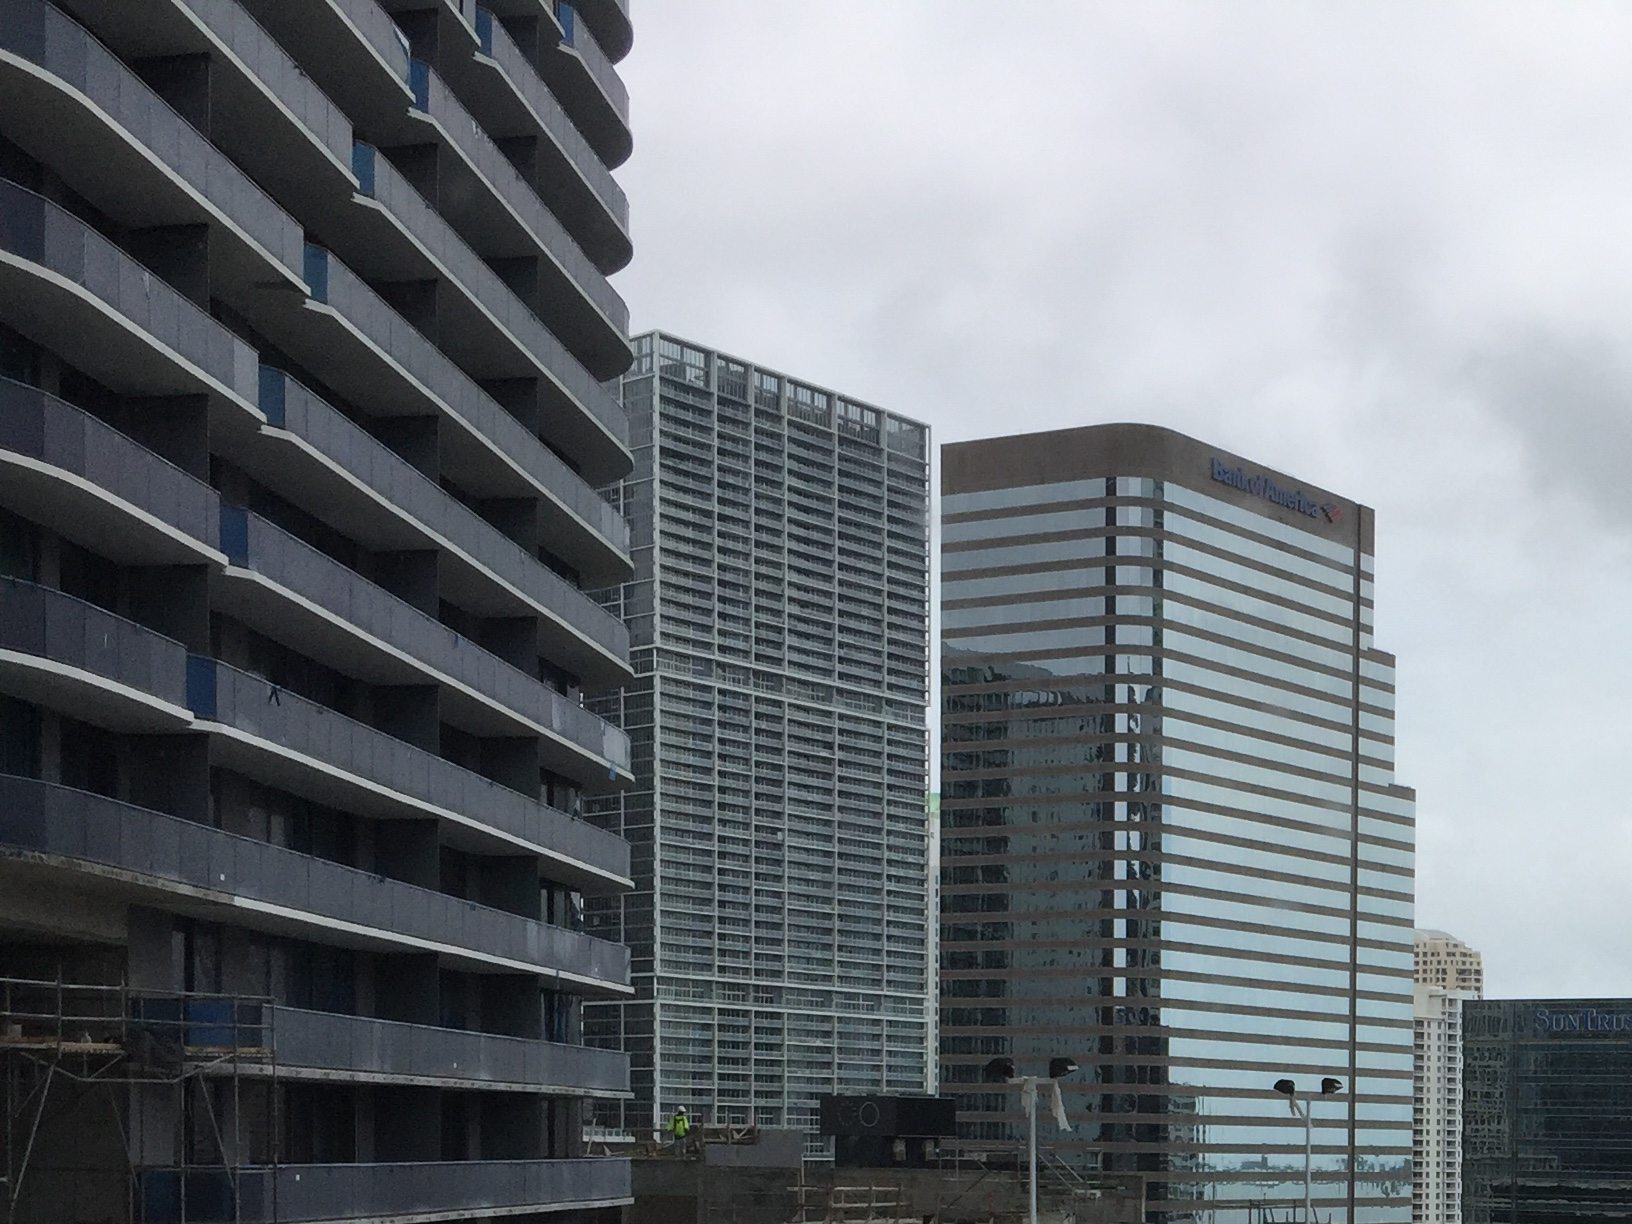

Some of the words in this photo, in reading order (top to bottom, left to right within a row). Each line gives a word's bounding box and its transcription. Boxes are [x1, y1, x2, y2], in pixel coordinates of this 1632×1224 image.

[1211, 456, 1249, 493] Bank
[1250, 474, 1265, 496] of
[1265, 478, 1321, 518] America
